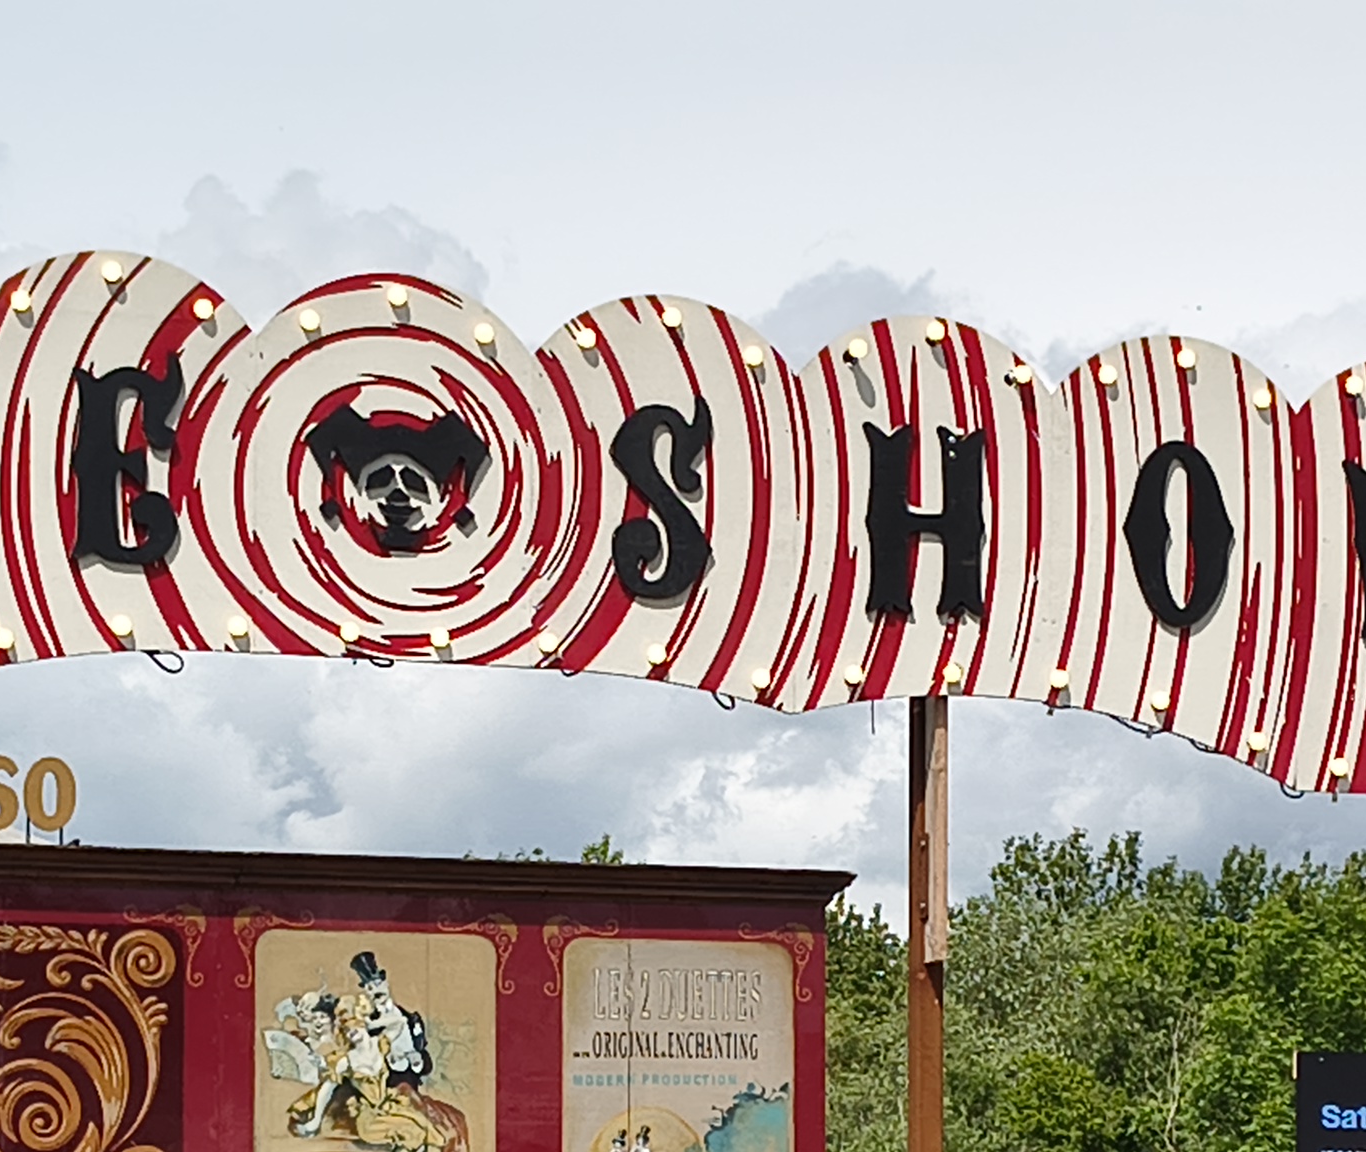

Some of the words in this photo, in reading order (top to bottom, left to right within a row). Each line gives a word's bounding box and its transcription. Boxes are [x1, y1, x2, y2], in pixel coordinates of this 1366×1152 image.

[640, 970, 651, 1020] 2
[572, 1074, 635, 1087] MODERN
[642, 1074, 738, 1087] PRODUCTION
